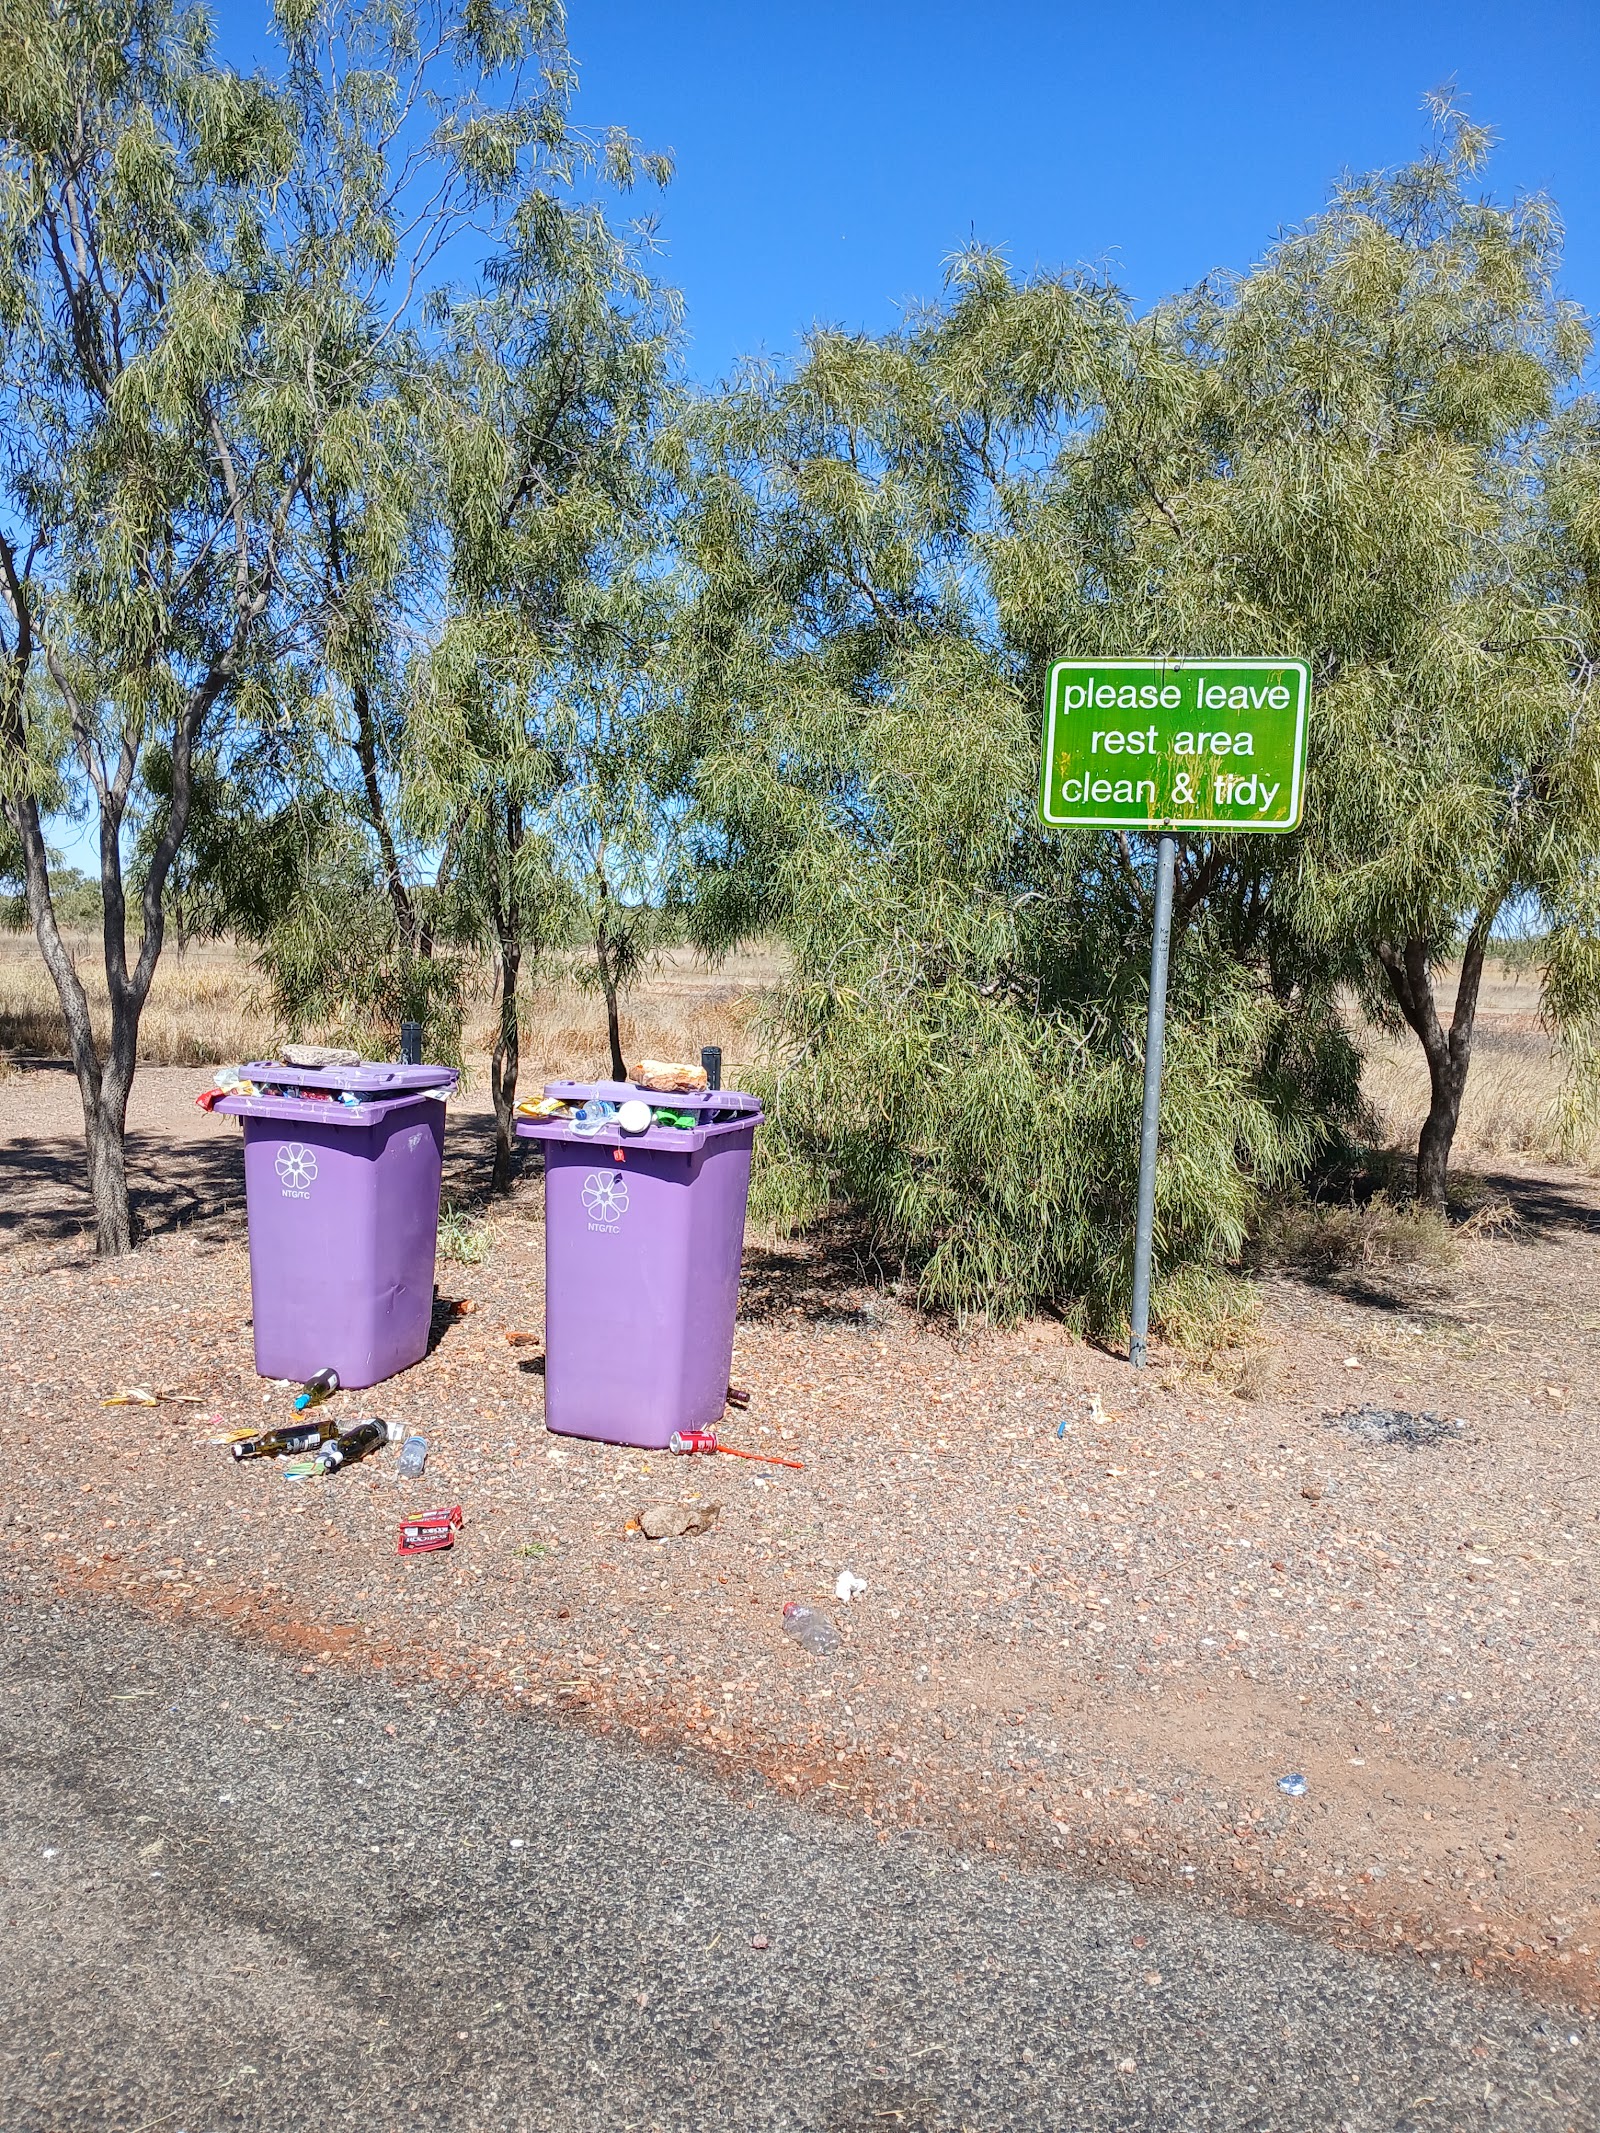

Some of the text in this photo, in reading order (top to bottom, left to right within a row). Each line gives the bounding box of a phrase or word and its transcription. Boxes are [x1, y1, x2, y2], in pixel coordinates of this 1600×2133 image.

[1063, 677, 1291, 715] please leave
[1091, 725, 1255, 757] rest area
[1061, 771, 1281, 813] clean & tidy
[281, 1189, 311, 1200] NTG/TC
[587, 1222, 620, 1234] NTG/TC
